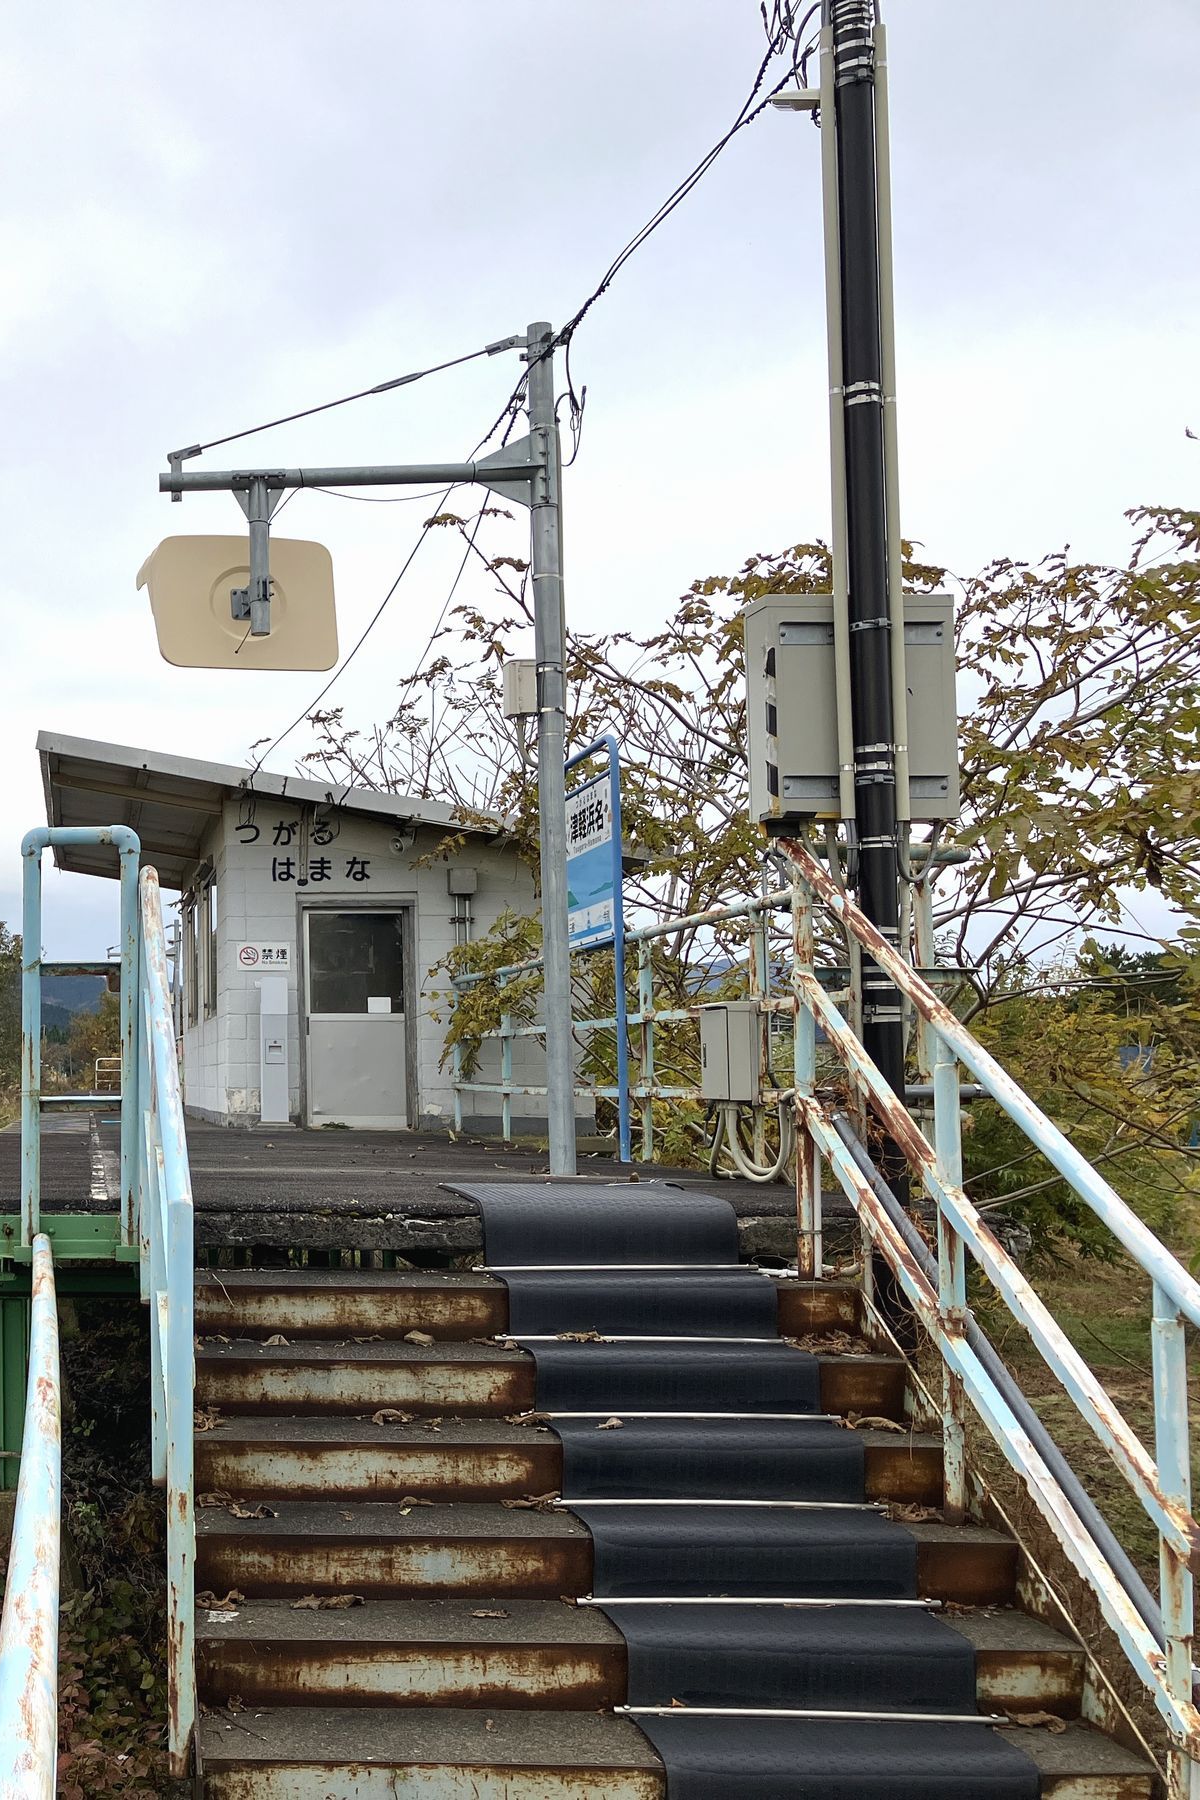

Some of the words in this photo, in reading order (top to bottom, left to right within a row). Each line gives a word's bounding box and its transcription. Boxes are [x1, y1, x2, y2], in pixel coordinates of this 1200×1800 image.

[235, 819, 334, 846] つがる
[272, 856, 371, 882] はまな
[261, 948, 288, 960] 禁煙
